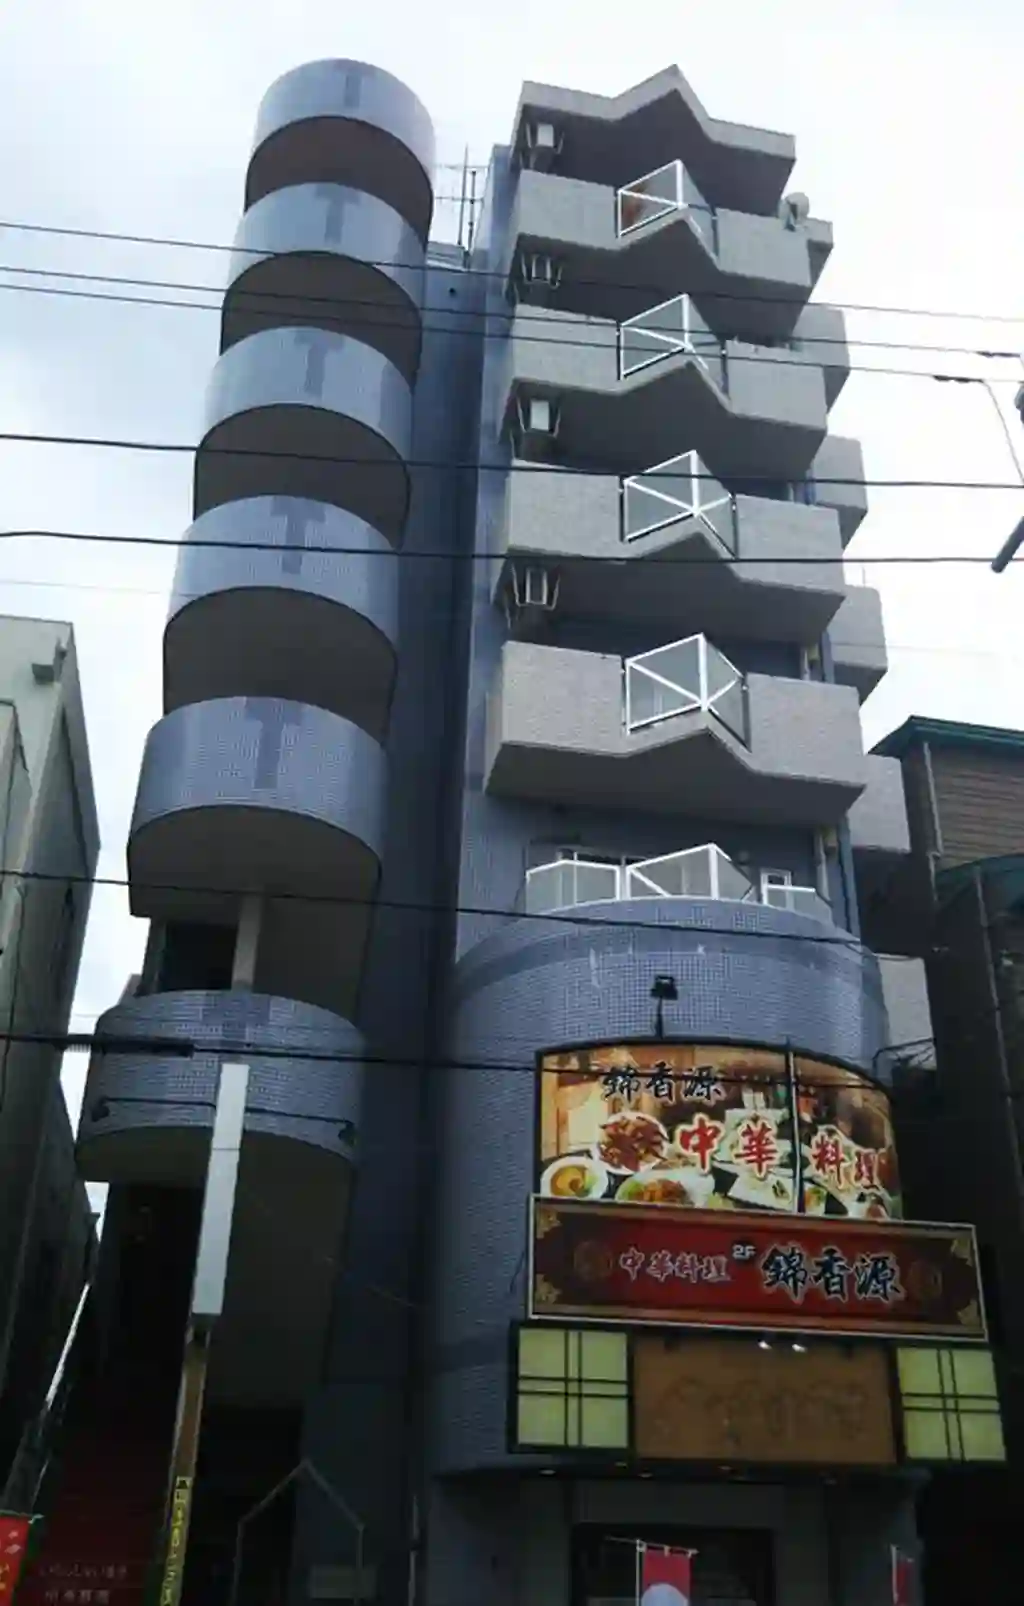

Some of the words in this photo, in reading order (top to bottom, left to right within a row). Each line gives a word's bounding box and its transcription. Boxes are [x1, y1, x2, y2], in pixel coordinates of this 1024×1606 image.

[602, 1061, 725, 1103] 錦香源
[678, 1115, 879, 1186] 中華料理
[620, 1246, 729, 1283] 中華料理
[732, 1244, 757, 1260] 2F
[763, 1243, 902, 1302] 錦香源
